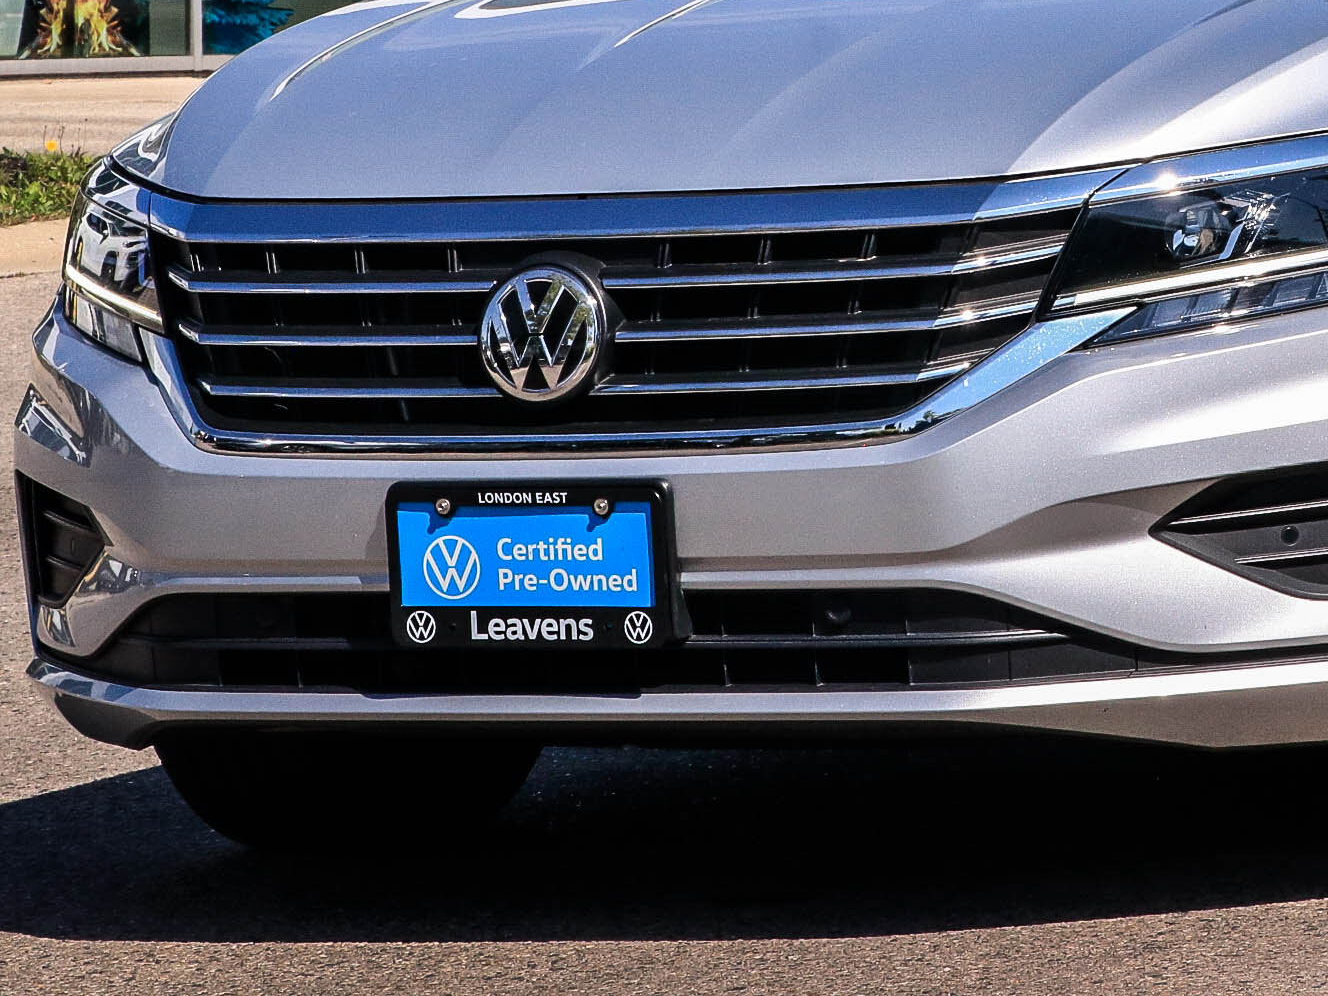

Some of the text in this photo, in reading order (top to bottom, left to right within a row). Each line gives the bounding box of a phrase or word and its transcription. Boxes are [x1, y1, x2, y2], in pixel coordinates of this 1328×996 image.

[477, 492, 568, 504] LONDON EAST
[496, 538, 603, 561] Certified
[498, 569, 638, 592] Pre-Owned
[470, 610, 594, 641] Leavens
